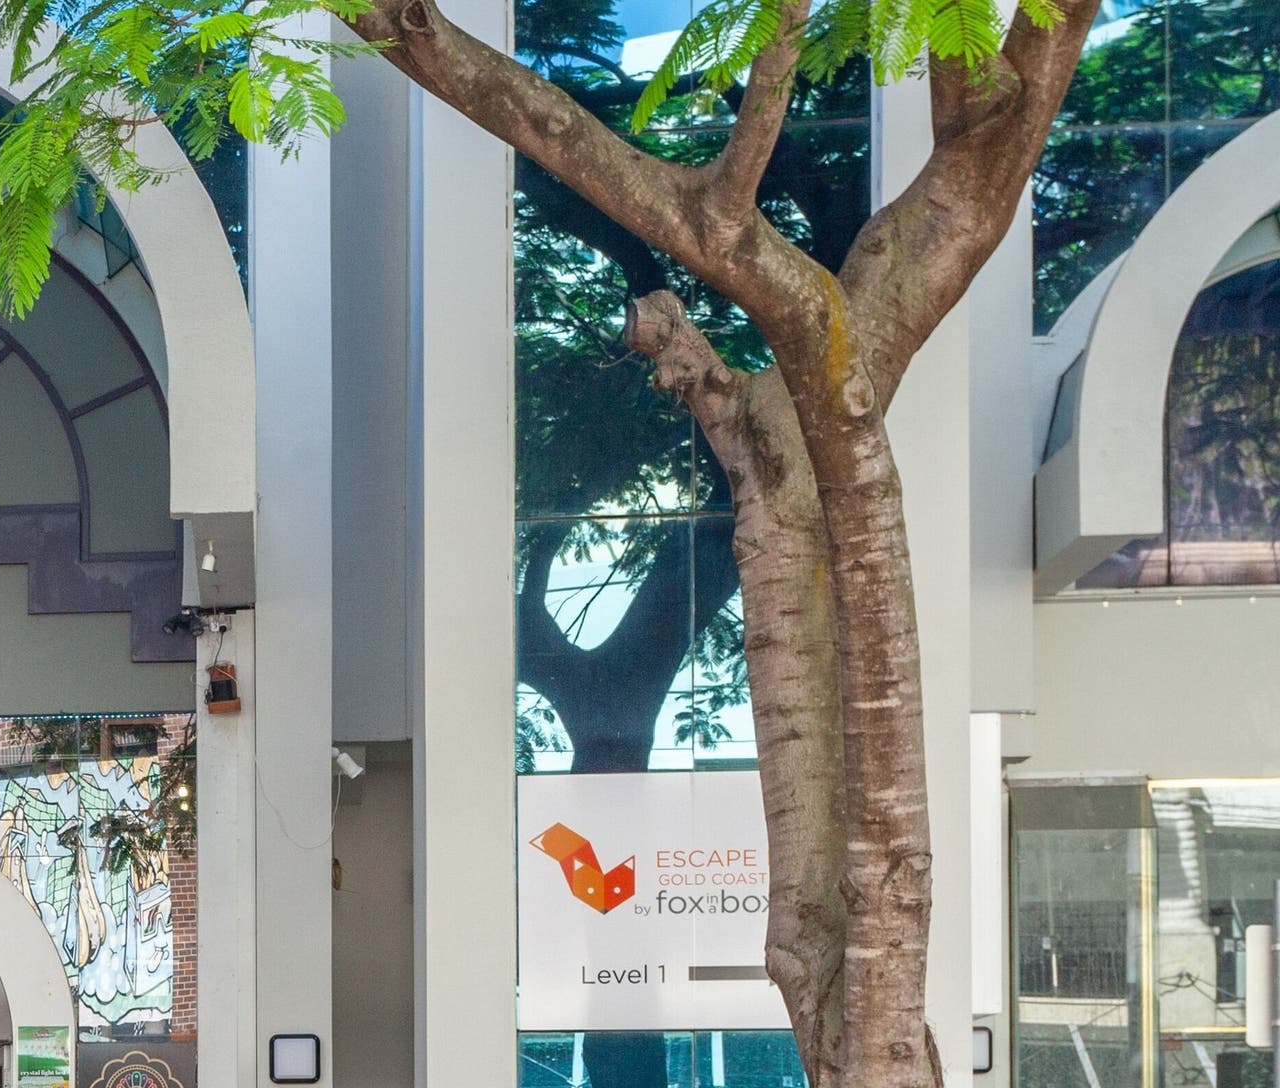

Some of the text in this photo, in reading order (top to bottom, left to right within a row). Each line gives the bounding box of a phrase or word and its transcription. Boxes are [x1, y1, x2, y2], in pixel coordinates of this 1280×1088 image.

[656, 849, 758, 868] ESCAPE
[658, 872, 768, 886] GOLD COAST
[634, 904, 652, 917] by
[656, 889, 704, 915] fox
[706, 892, 719, 904] in
[581, 964, 666, 984] Level 1
